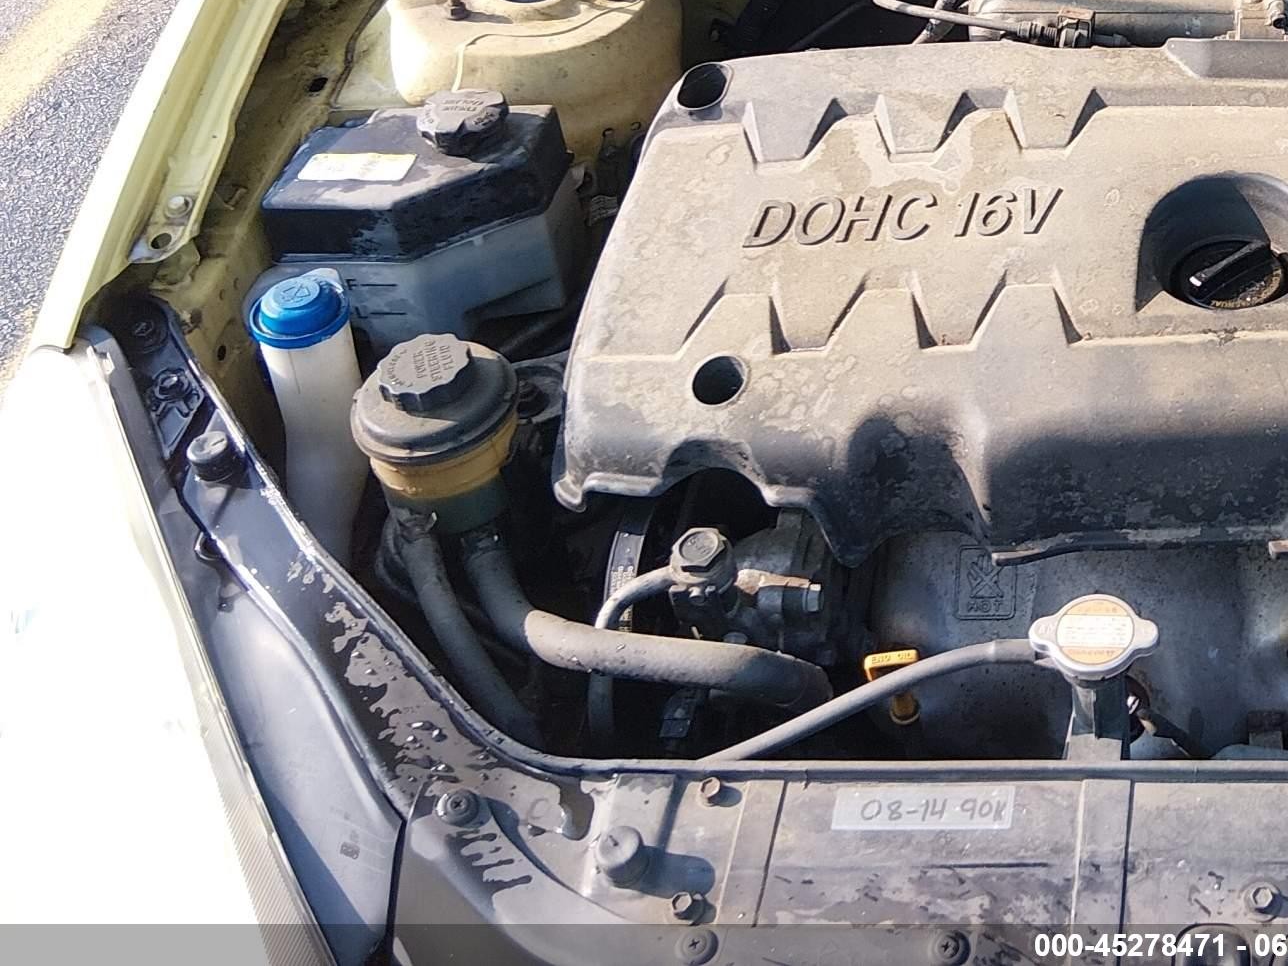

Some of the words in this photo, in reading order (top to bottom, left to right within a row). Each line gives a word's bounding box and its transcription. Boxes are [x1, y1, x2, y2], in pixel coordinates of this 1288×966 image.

[742, 195, 938, 250] DOHC
[952, 186, 1064, 239] 16V
[345, 278, 357, 291] F
[966, 600, 1003, 613] HOT
[860, 798, 948, 822] 08-14
